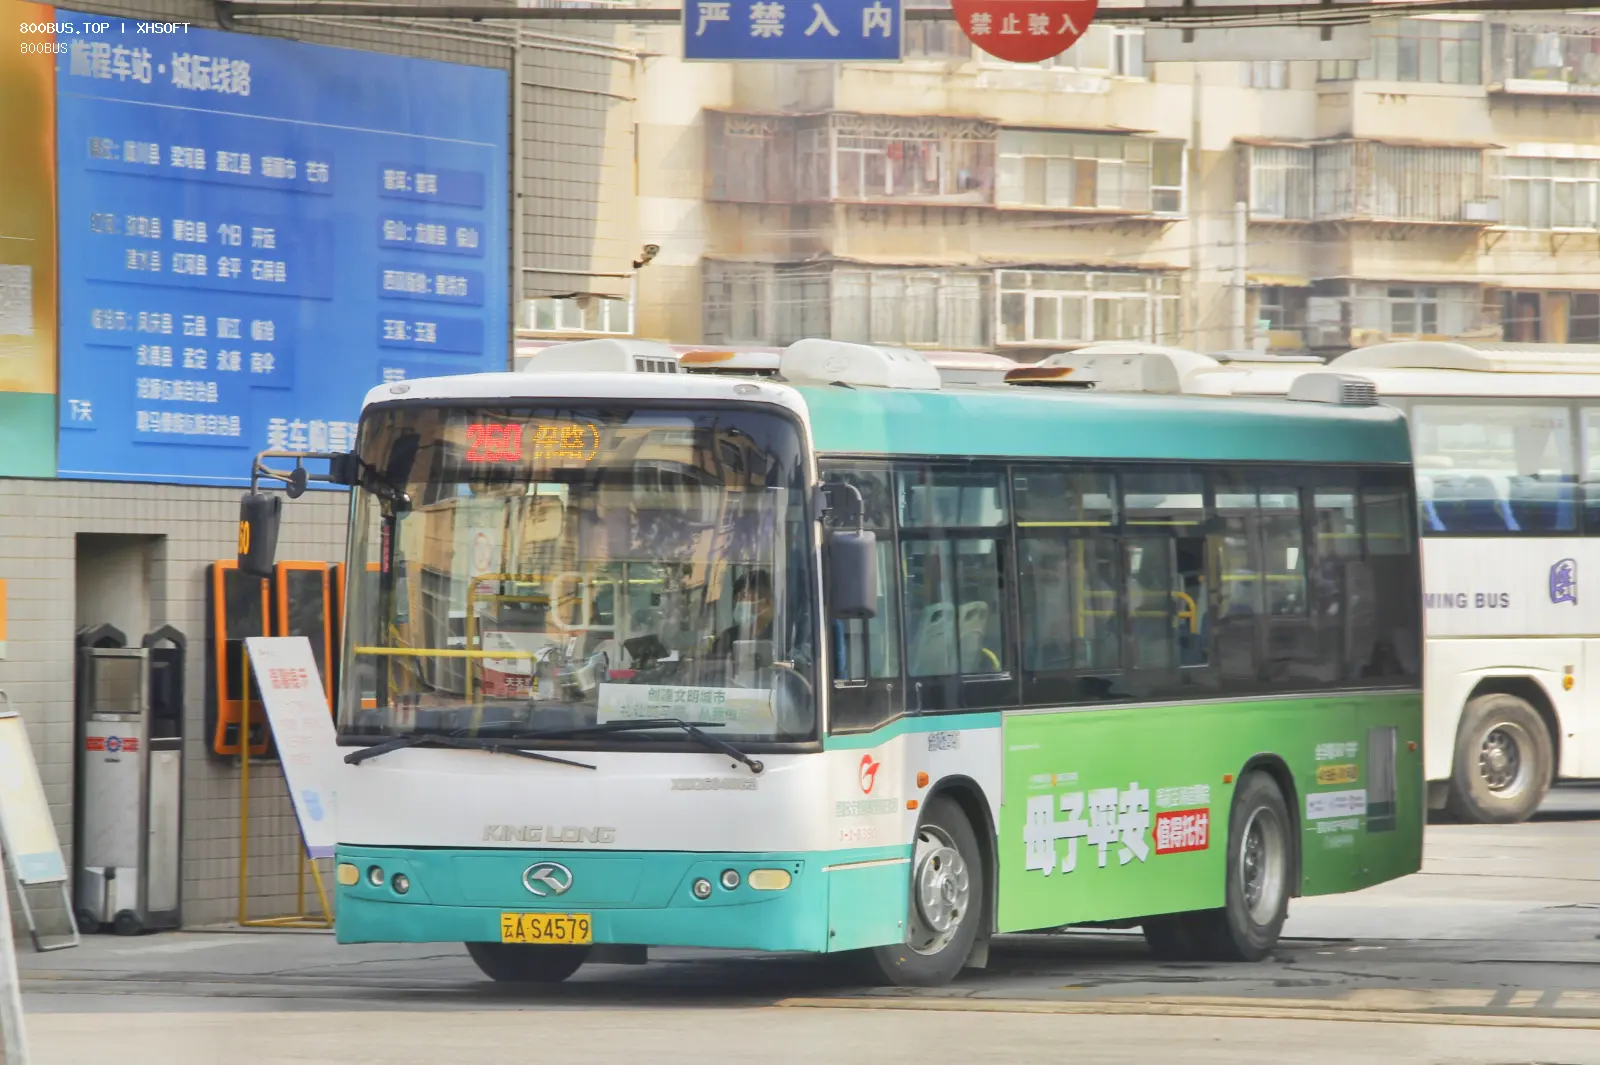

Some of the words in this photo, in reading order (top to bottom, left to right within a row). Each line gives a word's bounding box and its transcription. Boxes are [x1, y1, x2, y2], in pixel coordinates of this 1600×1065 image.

[696, 2, 891, 38] 严禁入内
[970, 12, 1080, 36] 禁止驶入
[466, 423, 523, 462] 260
[1474, 593, 1510, 609] BUS
[482, 824, 542, 842] KING
[545, 826, 616, 844] LONG
[1156, 813, 1209, 850] 值得托付
